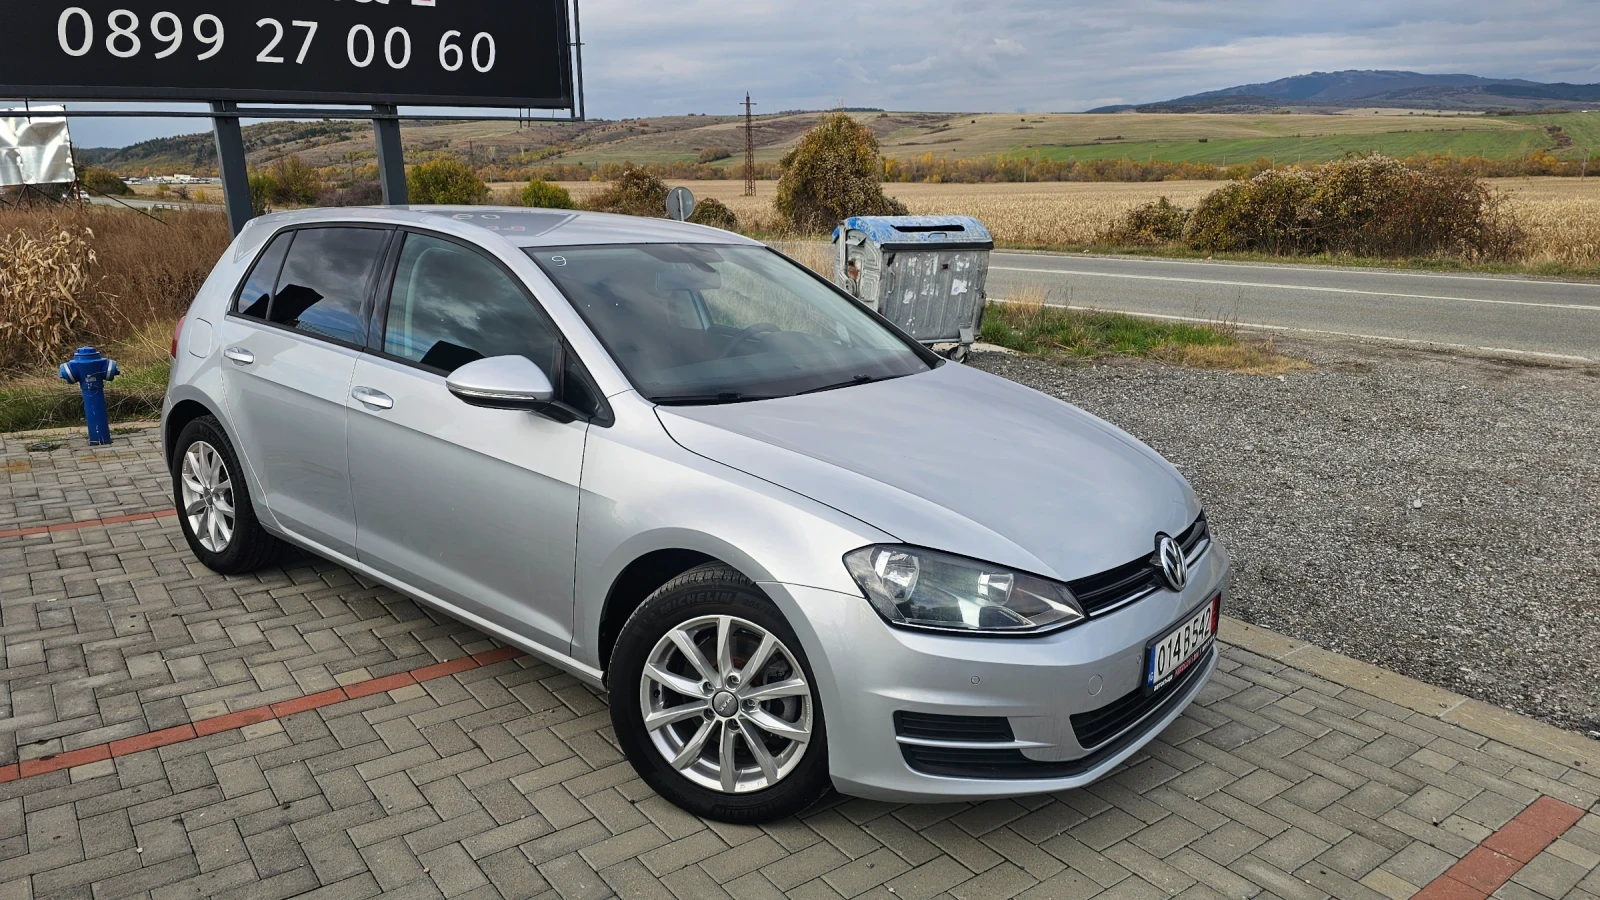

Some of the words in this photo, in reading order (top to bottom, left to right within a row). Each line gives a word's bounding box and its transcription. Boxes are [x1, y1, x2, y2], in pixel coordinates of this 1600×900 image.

[57, 6, 225, 61] 0899
[255, 17, 318, 65] 27
[346, 23, 412, 70] 00
[438, 29, 496, 73] 60
[551, 255, 567, 267] 9
[659, 591, 733, 616] MICHELIN
[718, 695, 733, 713] MAK
